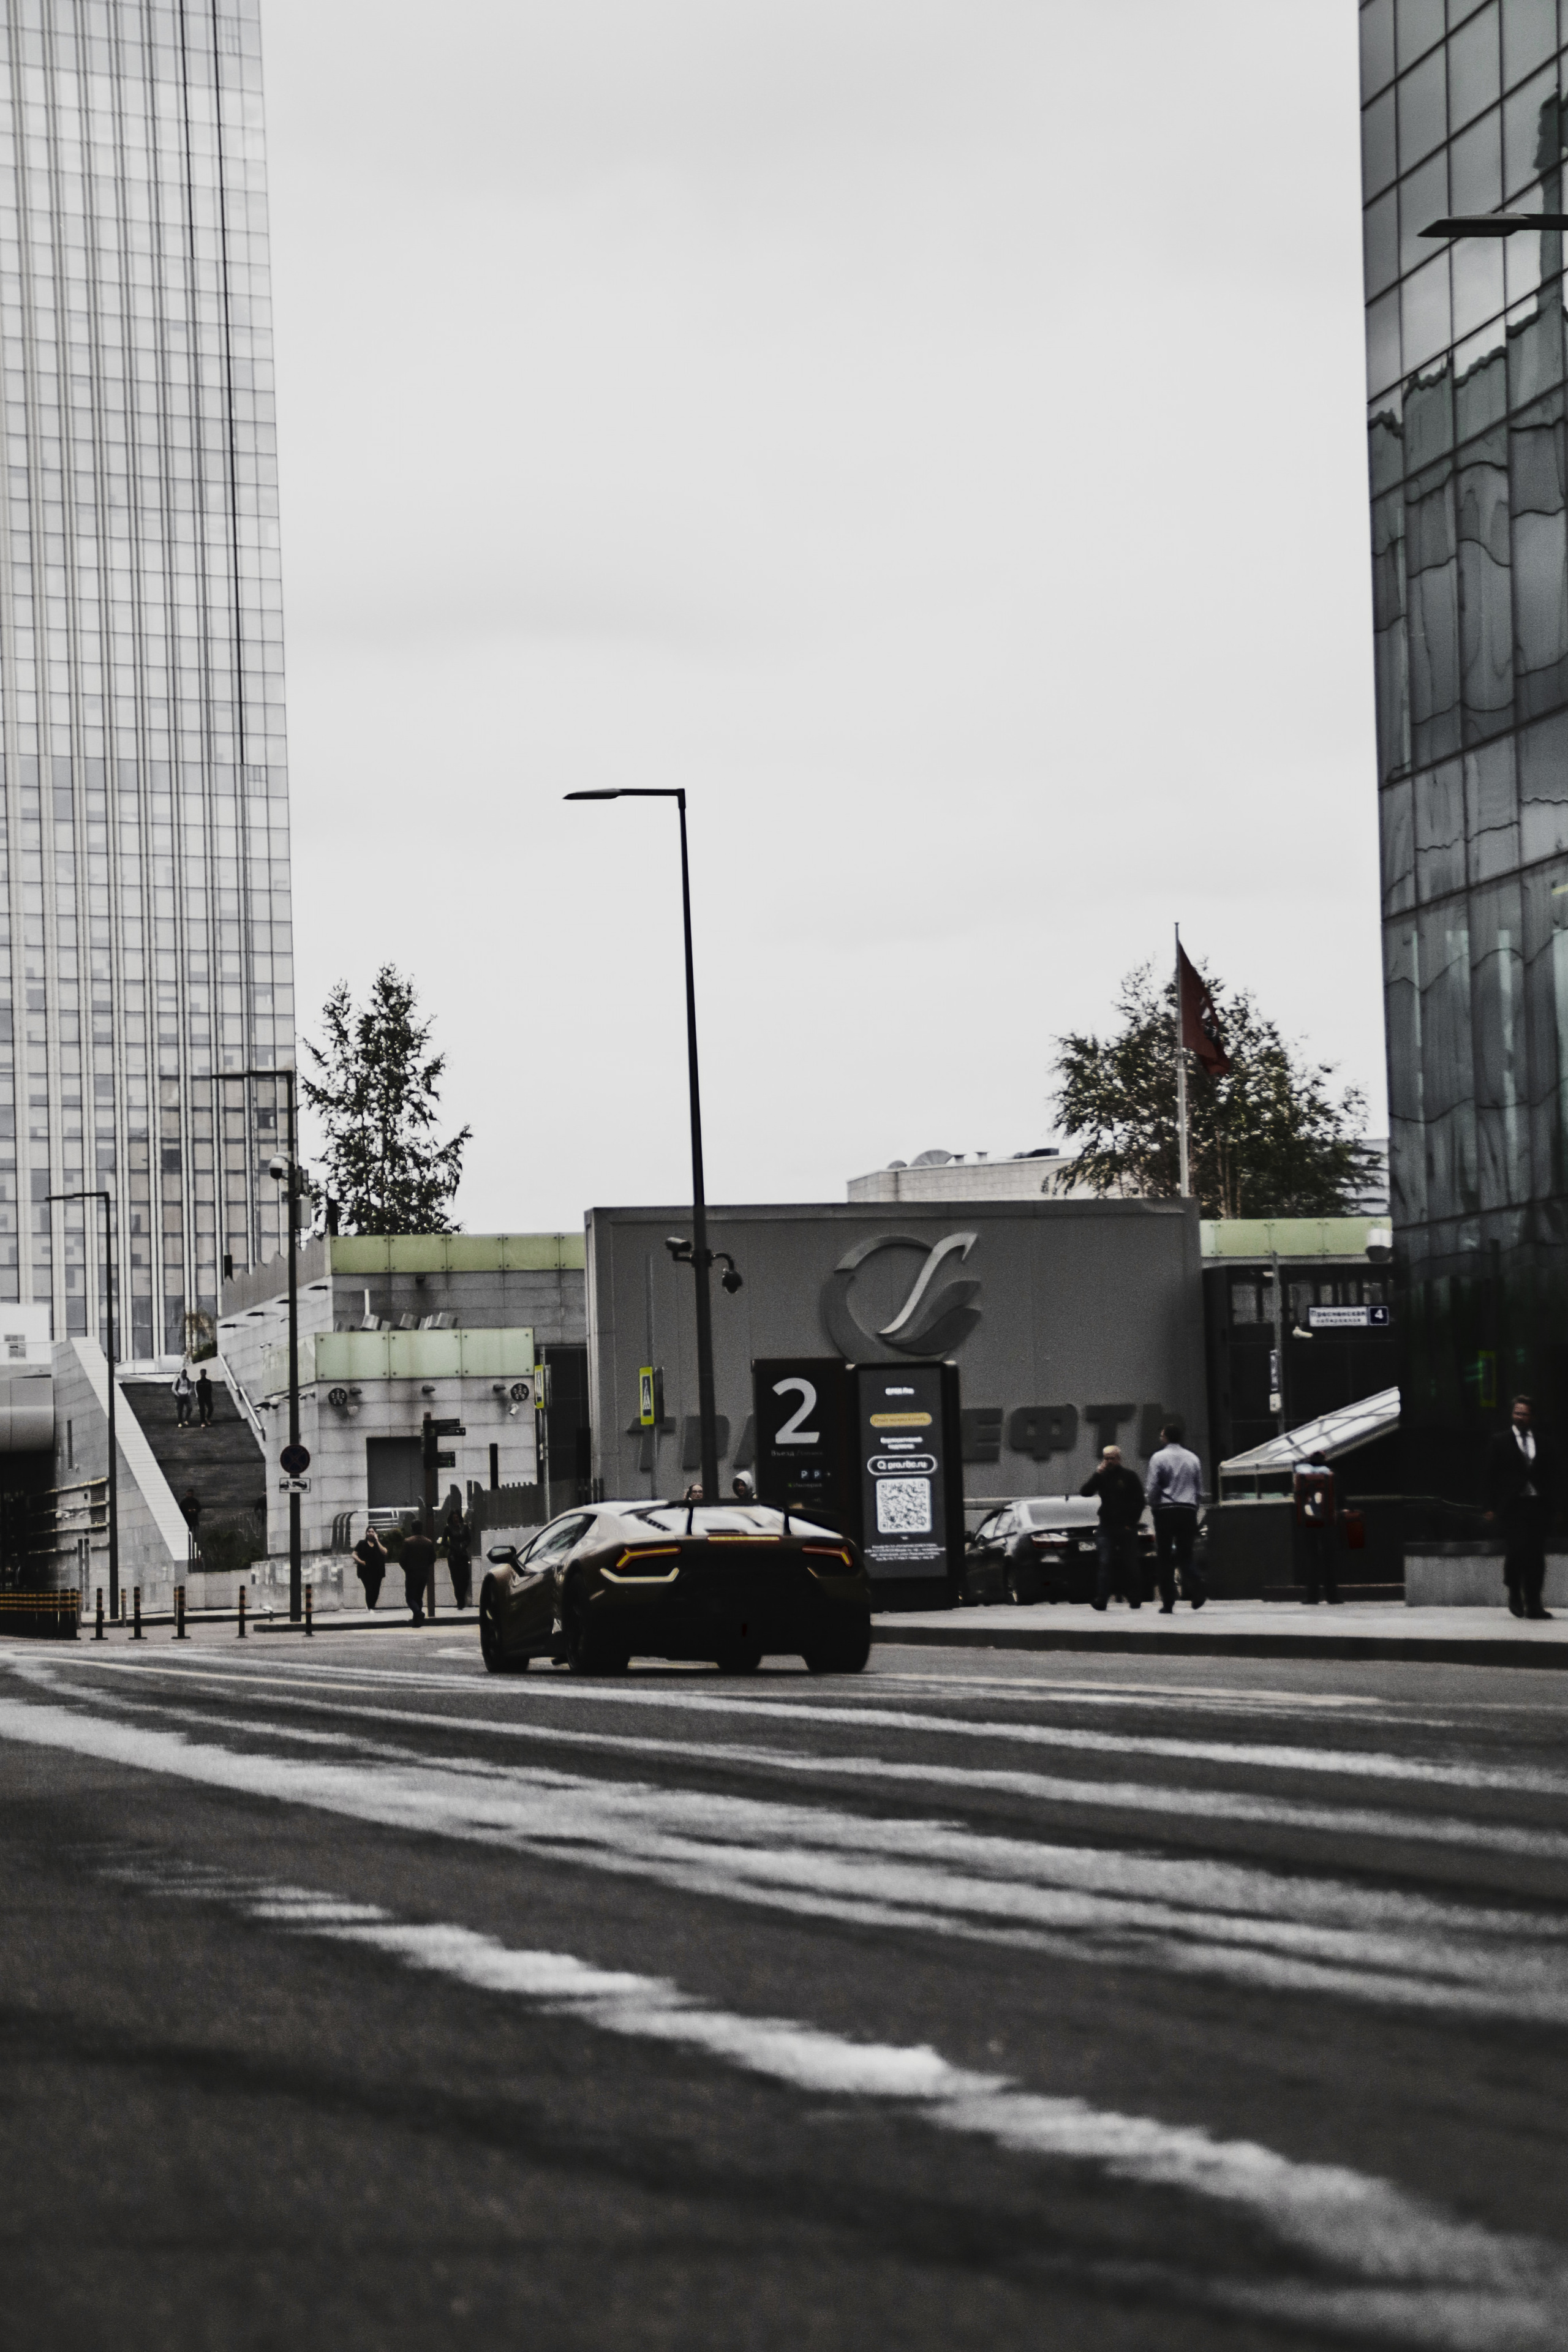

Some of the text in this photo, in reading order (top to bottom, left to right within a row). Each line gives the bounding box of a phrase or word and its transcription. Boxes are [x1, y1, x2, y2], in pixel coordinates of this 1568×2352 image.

[1374, 1309, 1384, 1319] 4
[772, 1378, 820, 1444] 2
[888, 1460, 927, 1469] pro.rbc.ru
